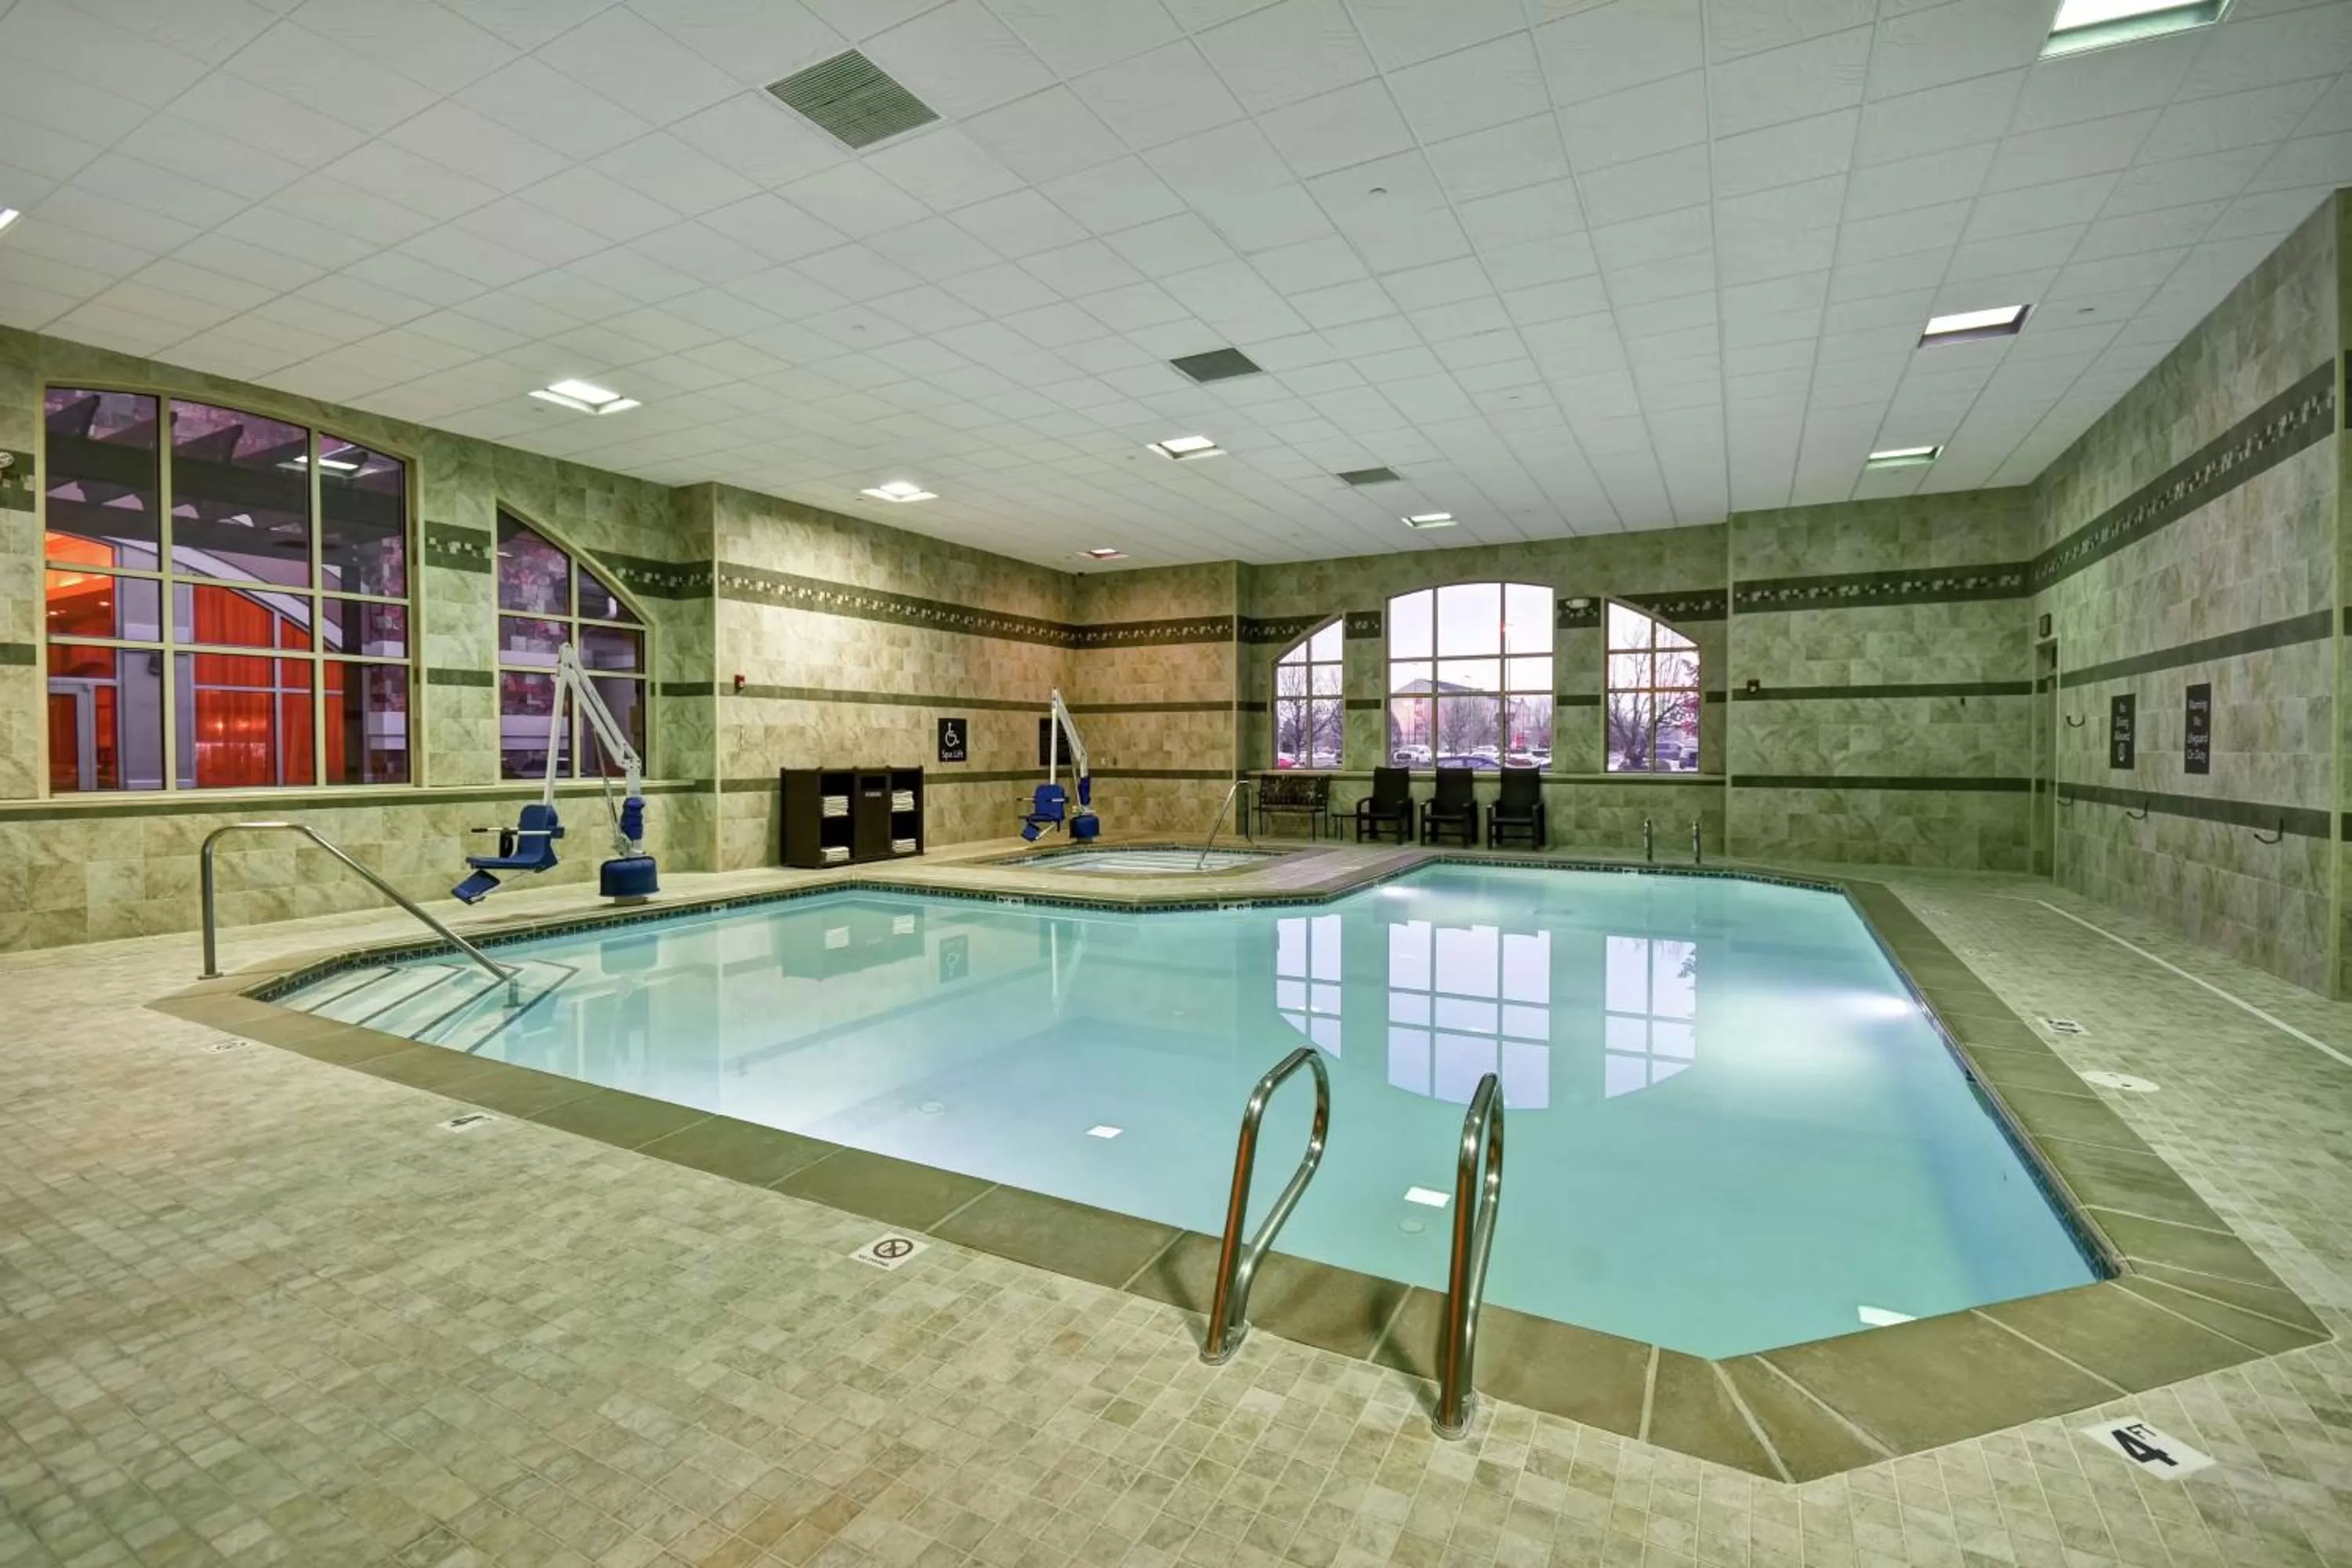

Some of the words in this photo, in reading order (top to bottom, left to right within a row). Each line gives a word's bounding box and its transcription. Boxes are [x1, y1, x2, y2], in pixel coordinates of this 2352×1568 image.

[942, 749, 953, 761] Spa
[2125, 1424, 2157, 1439] FT
[2111, 1429, 2179, 1467] 4
